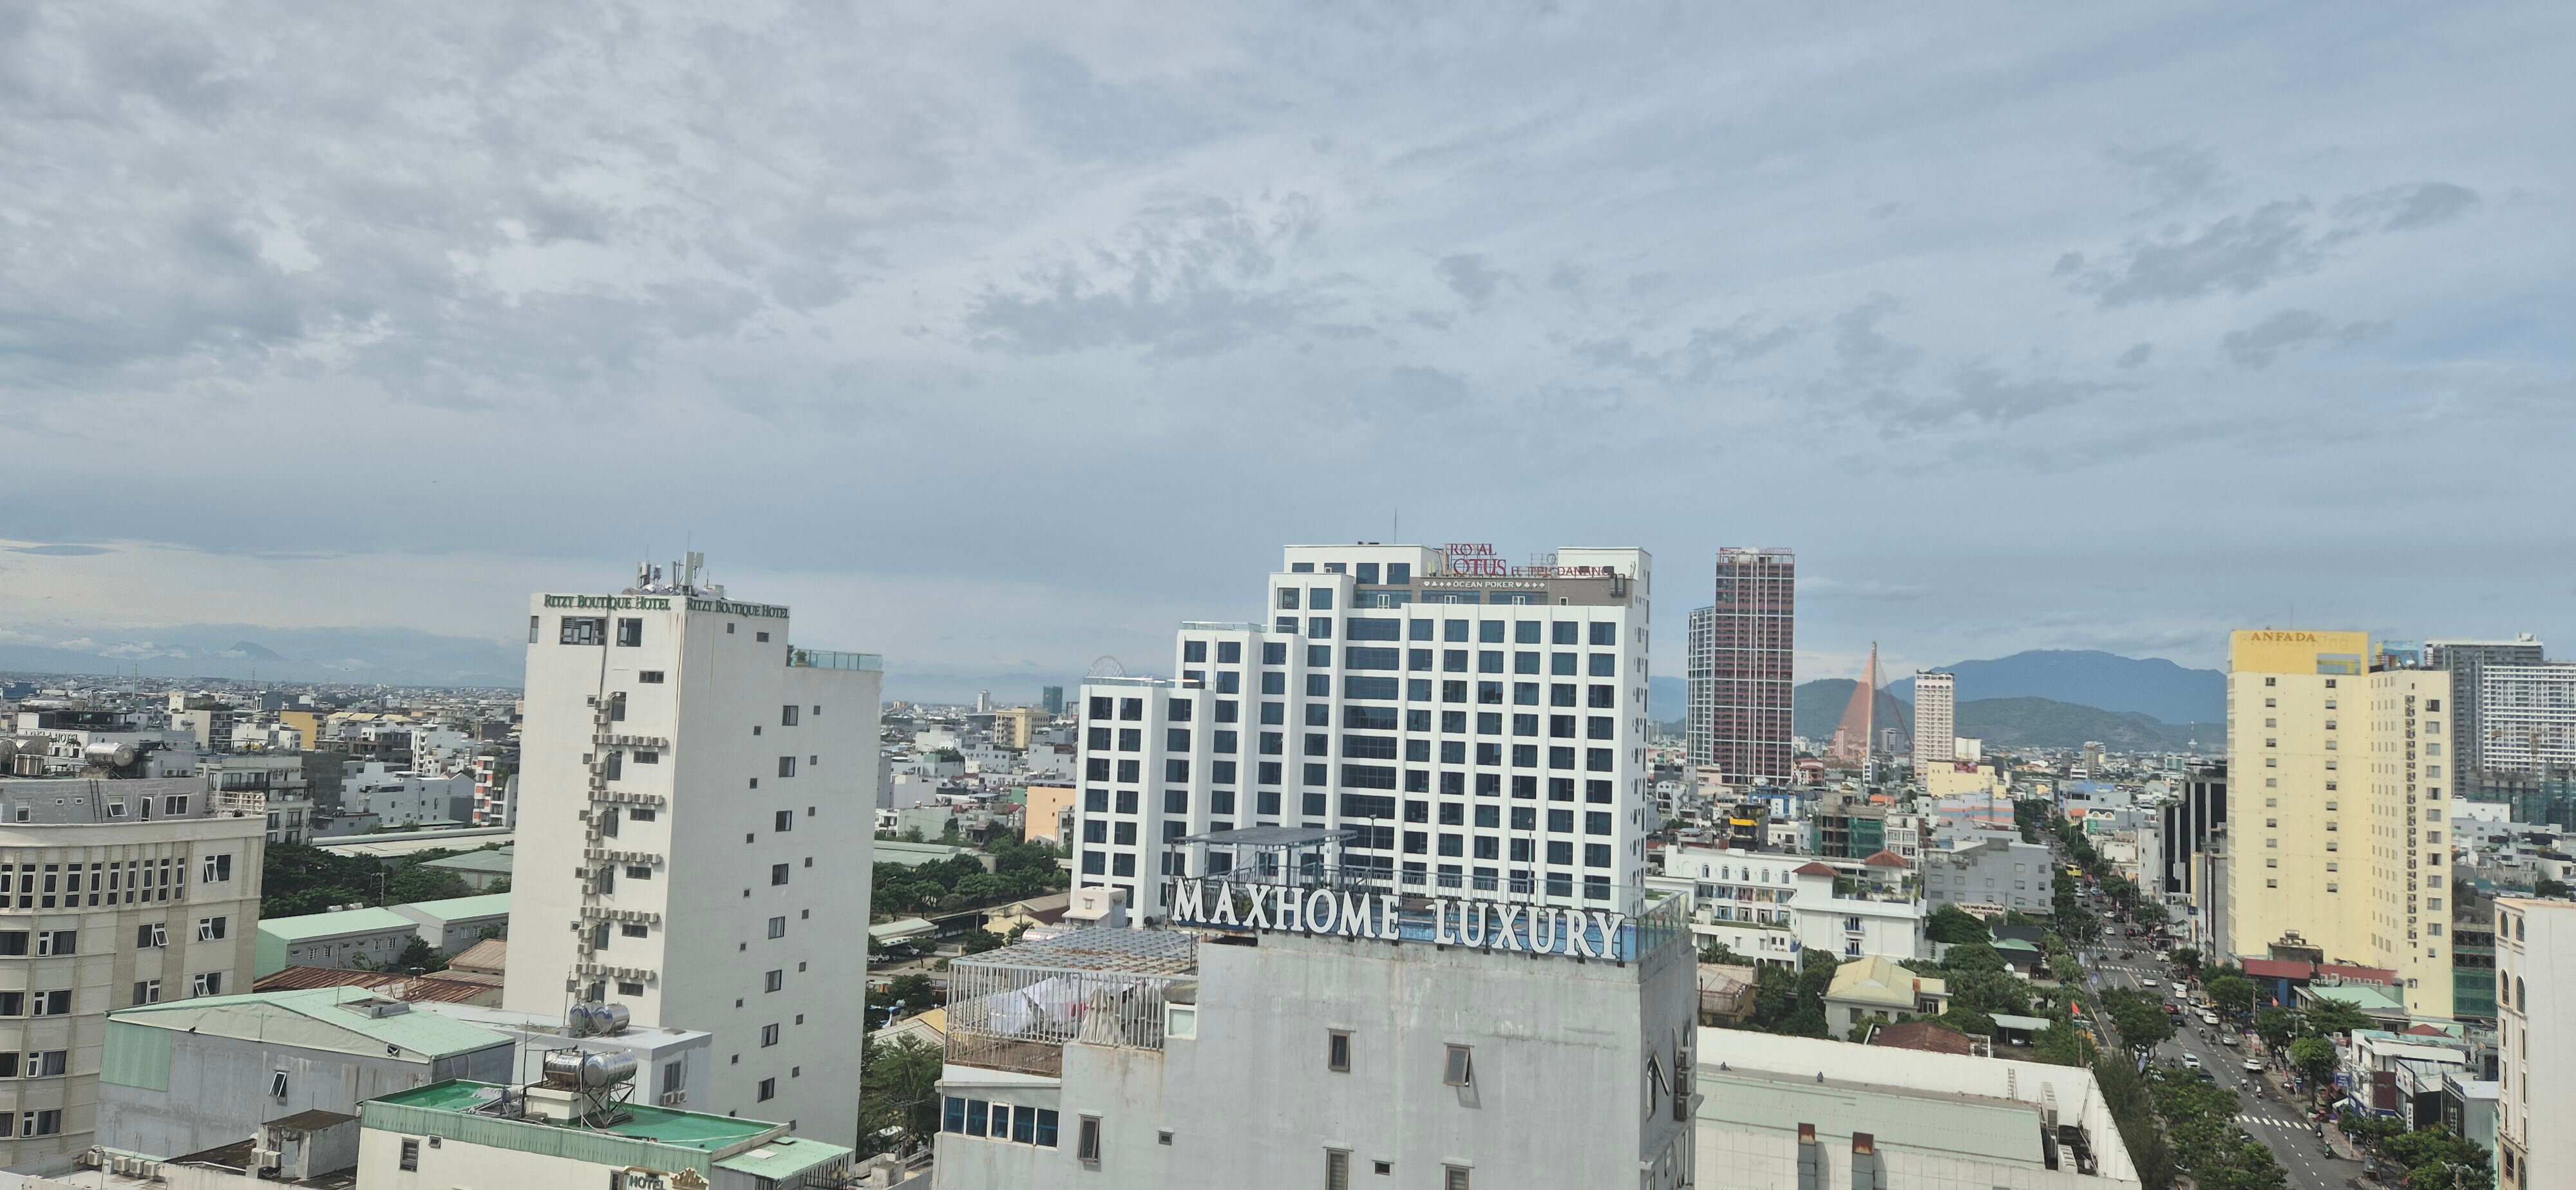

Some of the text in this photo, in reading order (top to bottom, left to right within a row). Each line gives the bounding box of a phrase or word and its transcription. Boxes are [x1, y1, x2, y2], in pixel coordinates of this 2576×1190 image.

[1557, 566, 1611, 576] DANANG
[544, 594, 670, 610] RITZY BOUTIQUE HOTEL
[687, 597, 790, 619] RITZY BOUTIQUE HOTEL
[2251, 632, 2316, 642] ANFADA
[1171, 877, 1626, 960] MAXHOME LUXURY
[629, 1175, 667, 1190] HOTEL
